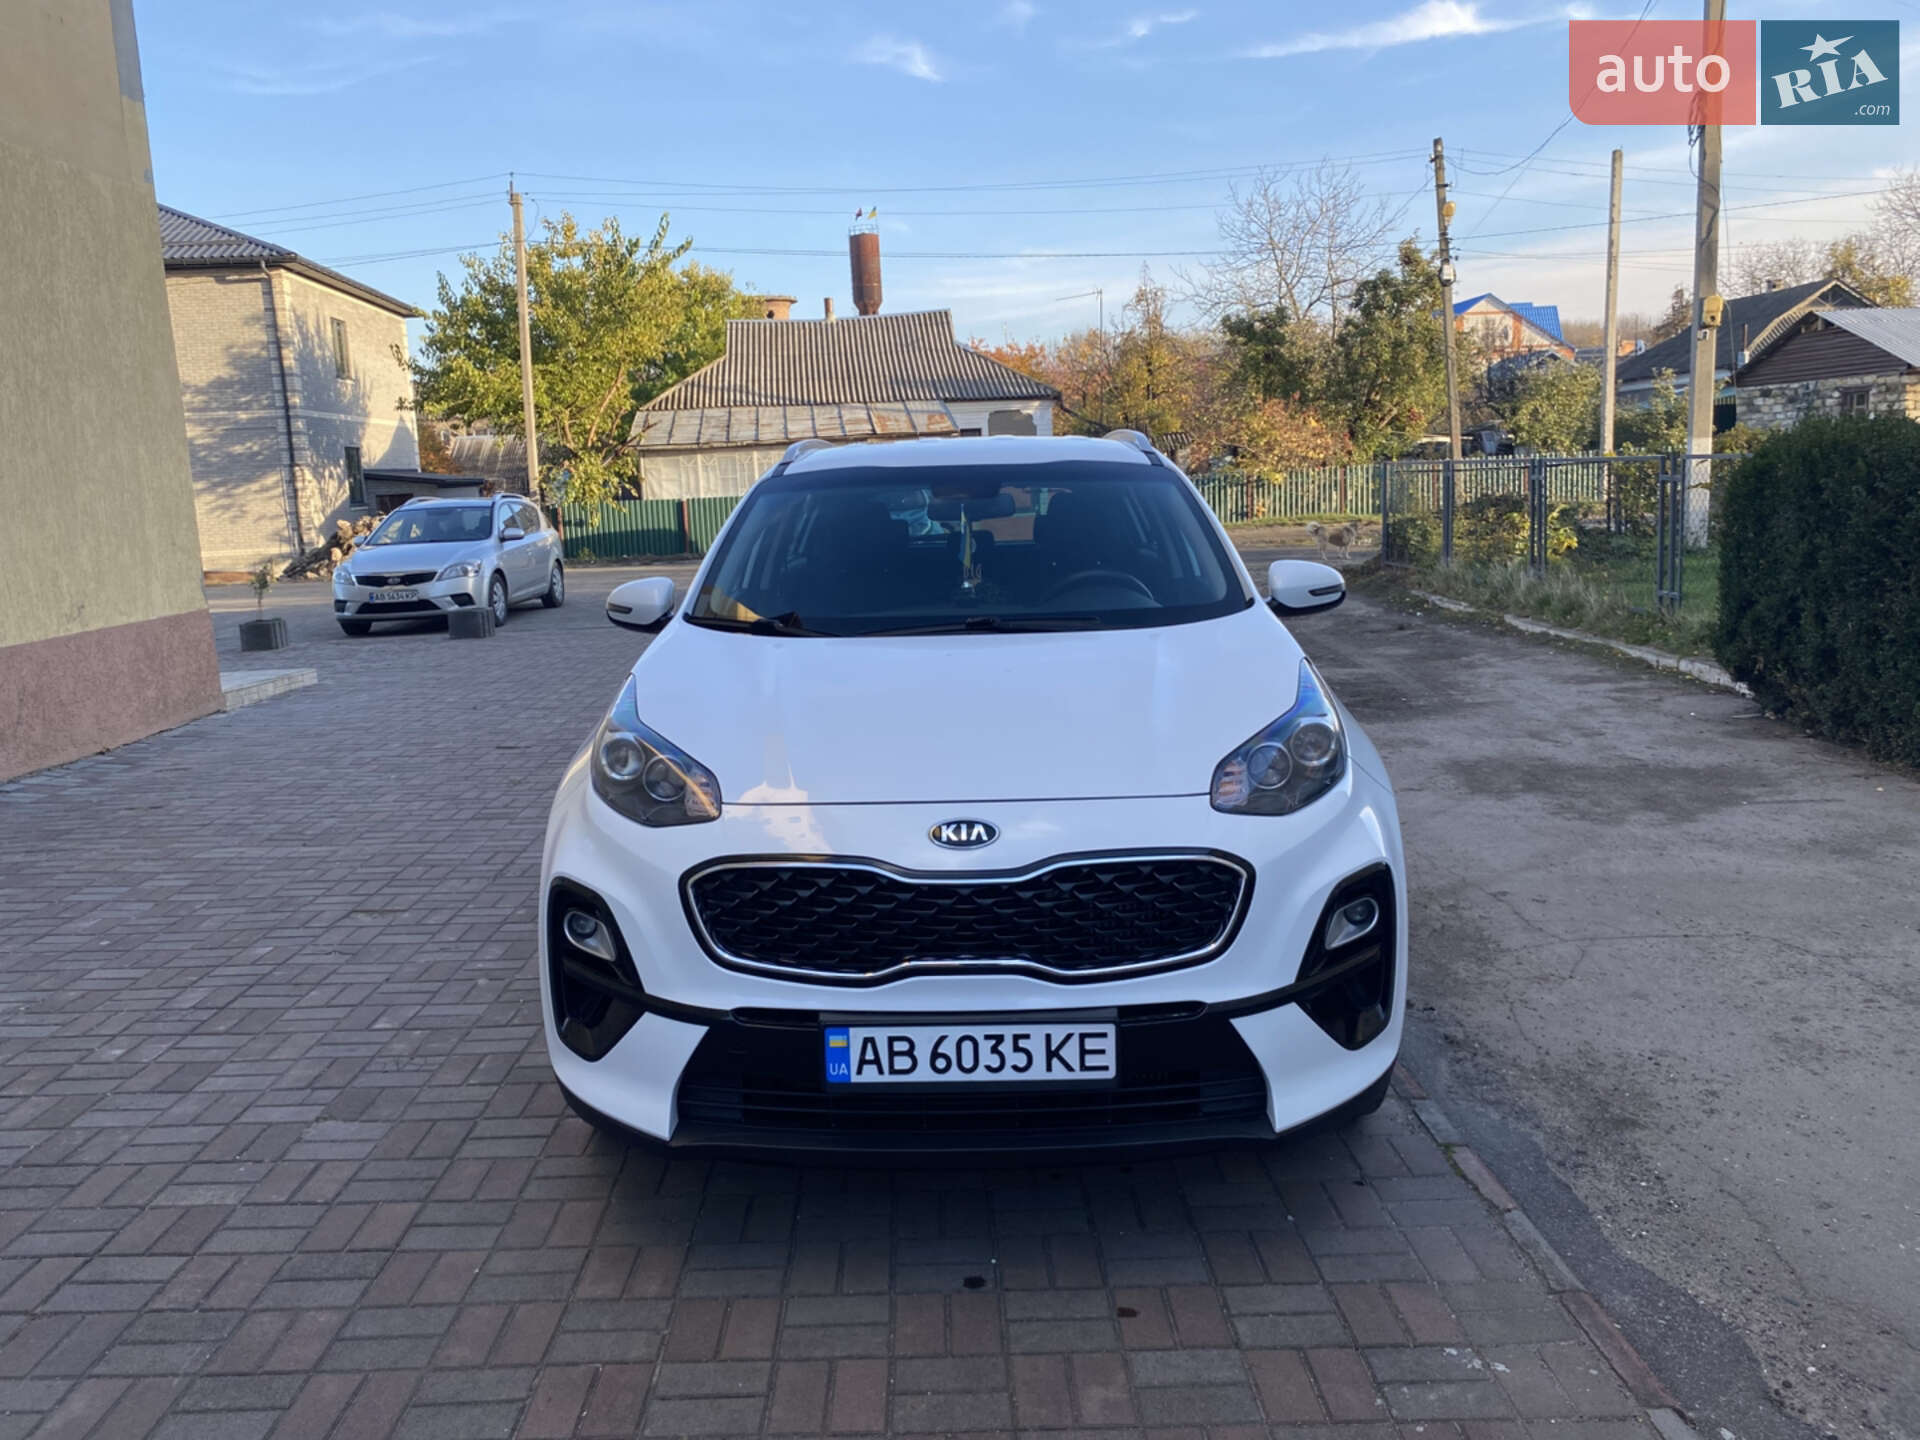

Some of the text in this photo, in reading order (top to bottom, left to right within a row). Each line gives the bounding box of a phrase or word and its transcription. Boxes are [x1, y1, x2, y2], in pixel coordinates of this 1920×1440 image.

[941, 823, 988, 841] KIA
[856, 1032, 1110, 1076] AB 6035 KE
[829, 1063, 848, 1075] UA
